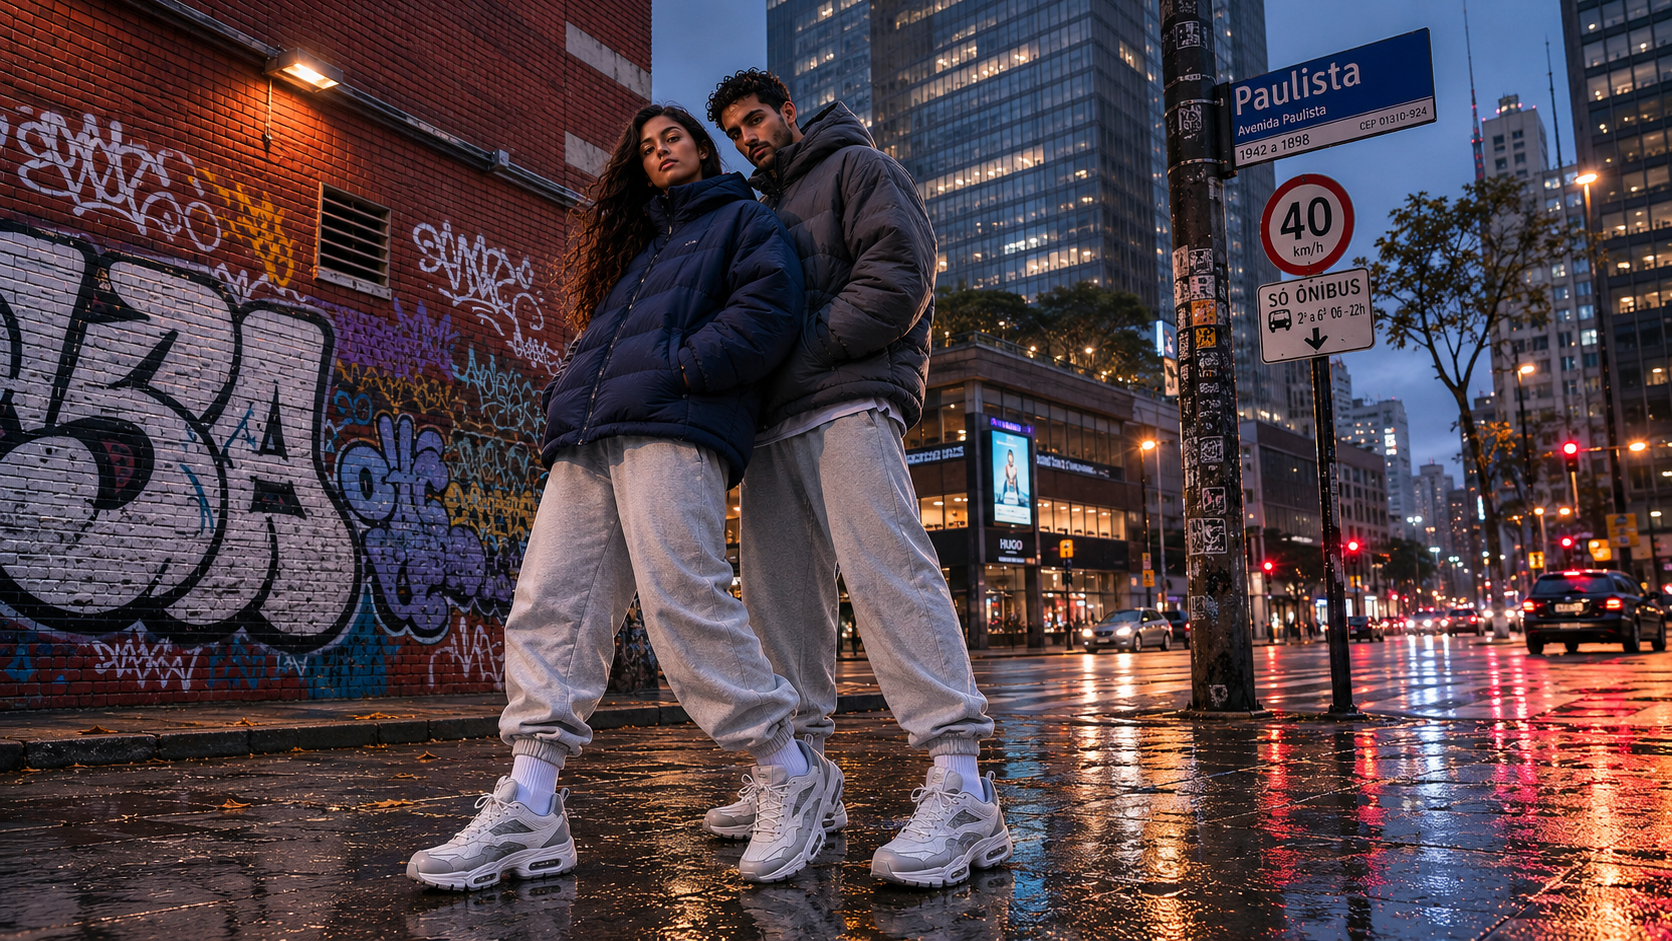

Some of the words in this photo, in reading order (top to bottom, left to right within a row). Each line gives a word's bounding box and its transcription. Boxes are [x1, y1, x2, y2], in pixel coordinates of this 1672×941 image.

[1235, 62, 1361, 116] Paulista
[1238, 117, 1280, 137] Avenida
[1282, 104, 1327, 126] Paulista
[1359, 120, 1377, 131] CEP
[1379, 106, 1427, 126] 01310-924
[1239, 144, 1268, 161] 1942
[1271, 143, 1277, 152] a
[1281, 133, 1310, 151] 1898
[1280, 196, 1332, 241] 40
[1293, 241, 1324, 257] km/h
[1268, 287, 1289, 307] SÓ
[1309, 312, 1315, 322] a
[999, 538, 1023, 550] HUGO
